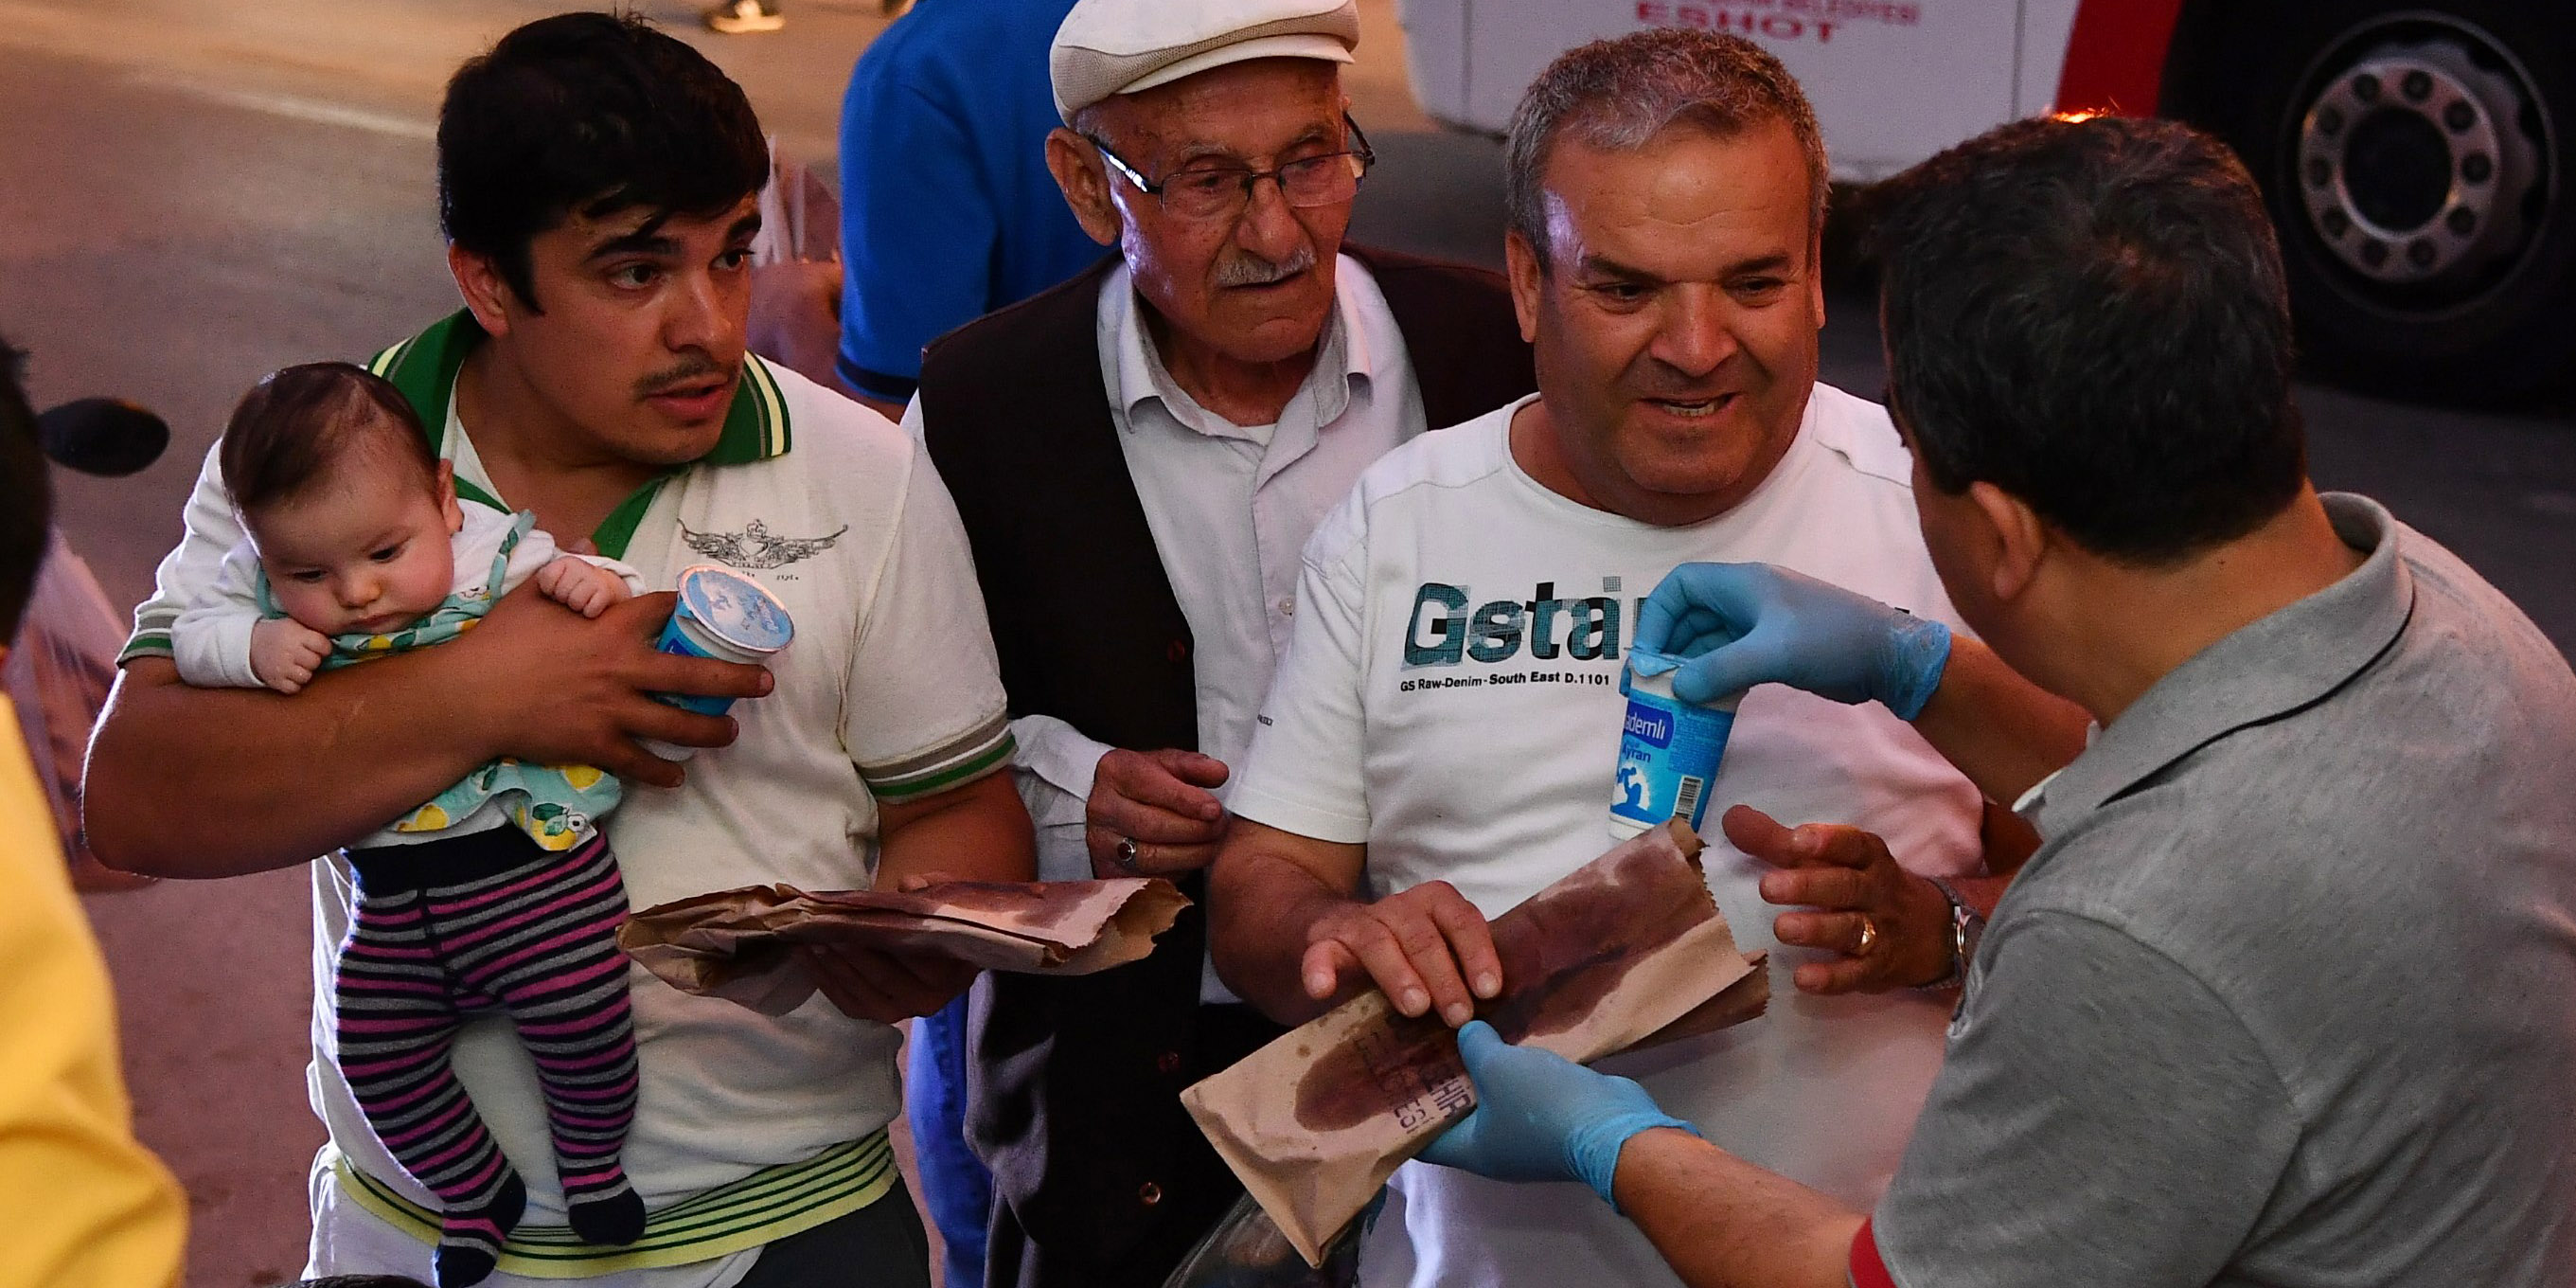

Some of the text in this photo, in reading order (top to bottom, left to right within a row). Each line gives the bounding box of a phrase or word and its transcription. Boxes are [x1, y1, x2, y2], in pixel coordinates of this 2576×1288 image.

[1637, 1, 1838, 44] ESHOT
[1400, 680, 1416, 691] GS
[1530, 671, 1560, 683] East
[1564, 672, 1609, 686] D.1101
